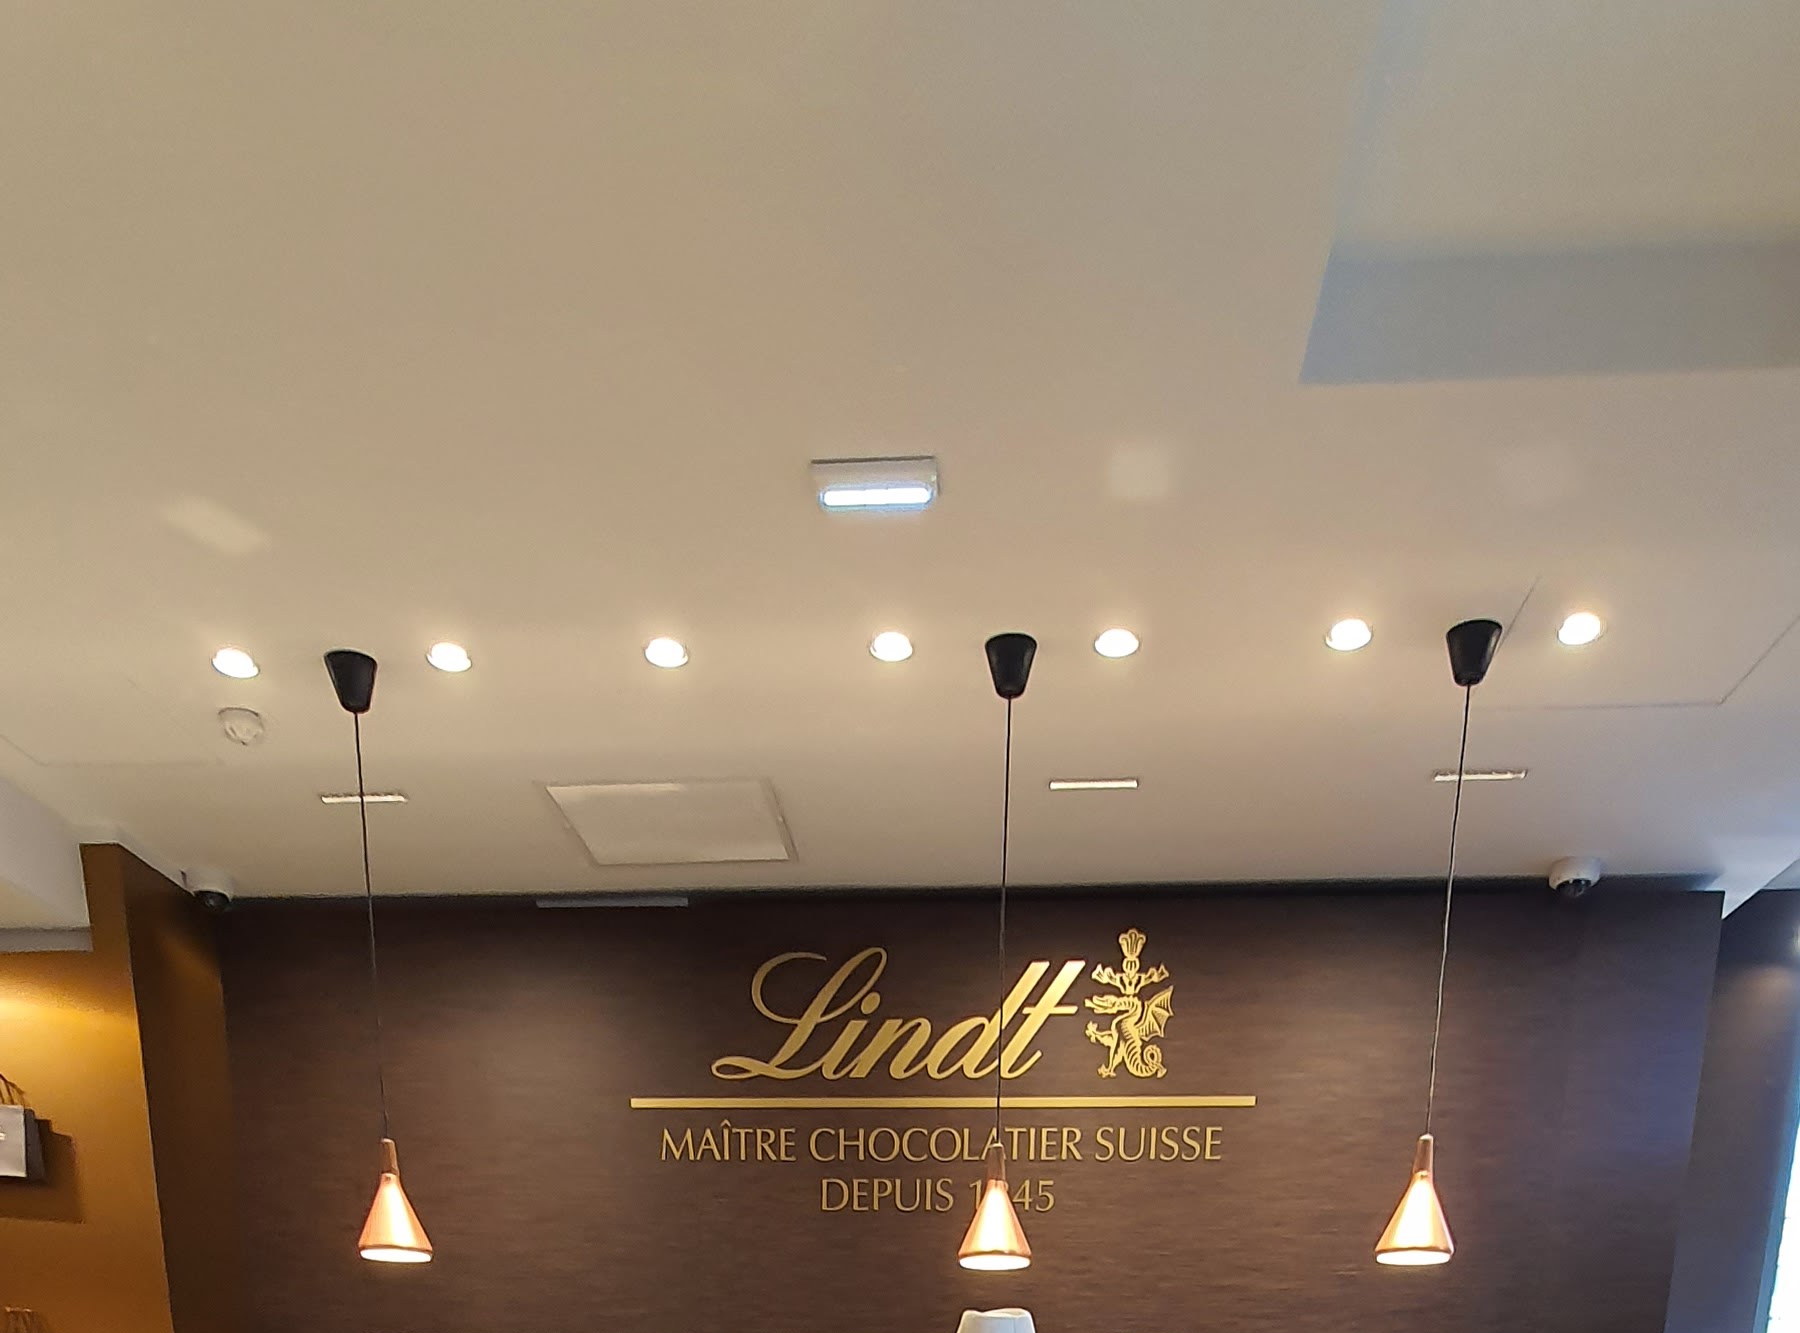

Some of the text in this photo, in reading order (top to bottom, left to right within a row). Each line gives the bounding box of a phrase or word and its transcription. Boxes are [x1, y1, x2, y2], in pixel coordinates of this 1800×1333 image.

[710, 946, 1086, 1080] Lindt
[659, 1119, 1223, 1162] MAÎTRE CHOCOLATIER SUISSE
[820, 1178, 1055, 1212] DEPUIS 145
